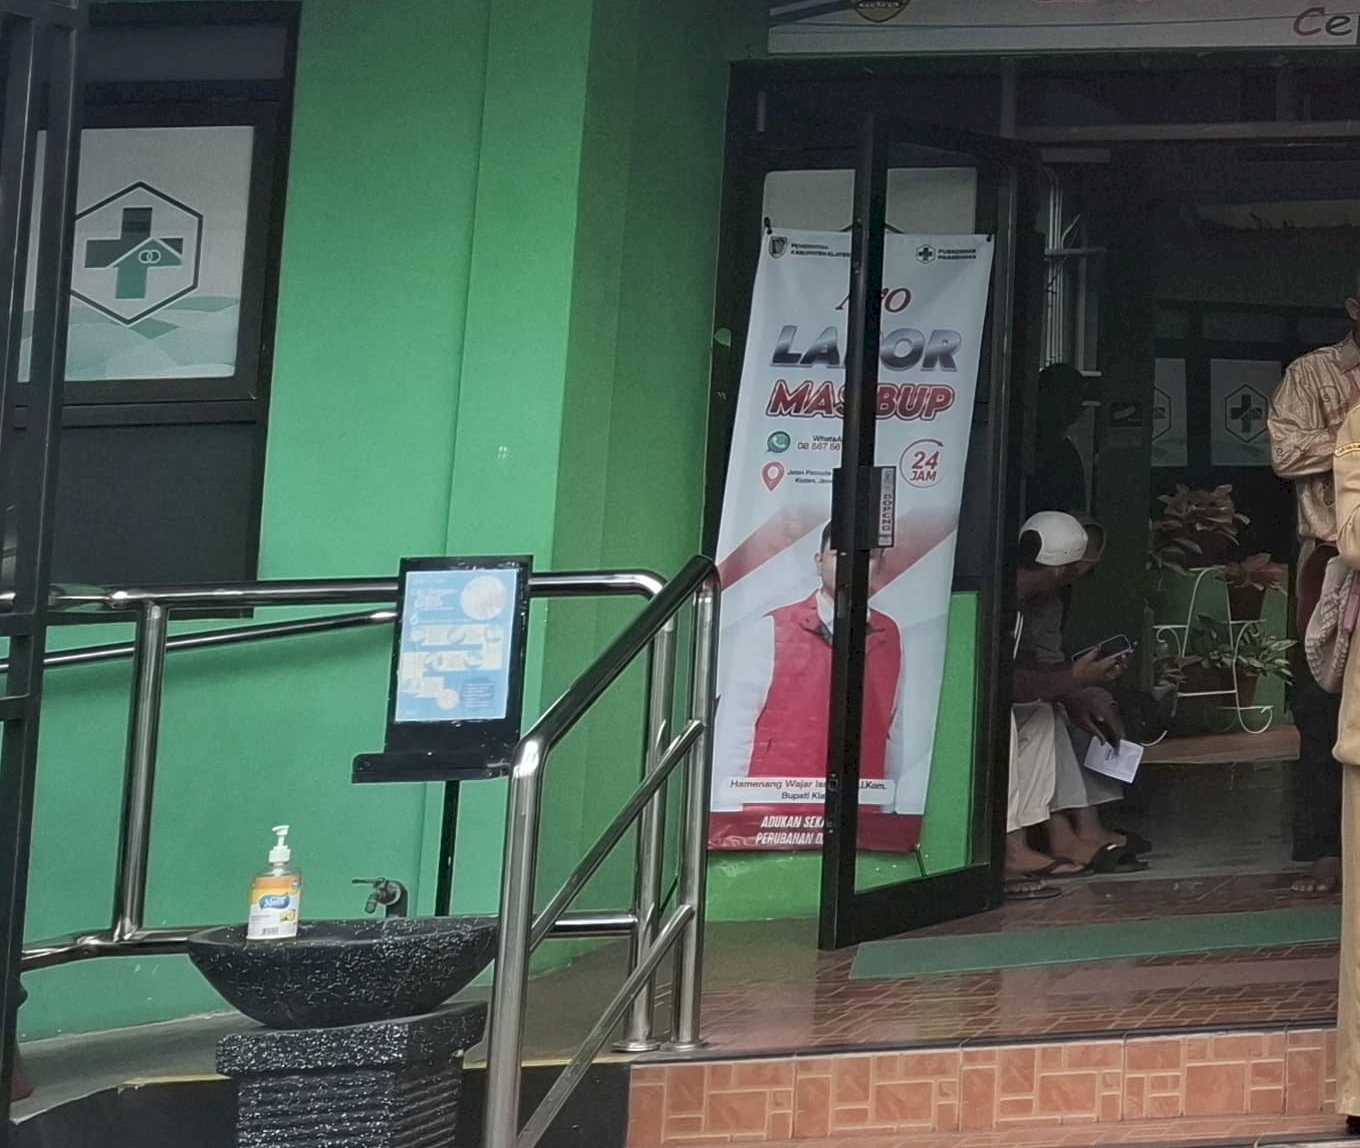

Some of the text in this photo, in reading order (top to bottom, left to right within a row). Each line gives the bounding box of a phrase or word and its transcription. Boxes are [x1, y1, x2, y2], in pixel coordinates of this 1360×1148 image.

[770, 324, 962, 373] LAOR
[911, 451, 940, 470] 24
[909, 470, 937, 481] JAM
[730, 779, 783, 789] Hamenang
[782, 791, 809, 801] Bupati
[760, 815, 802, 829] ADUKAN
[755, 832, 812, 846] PERUBAHAN
